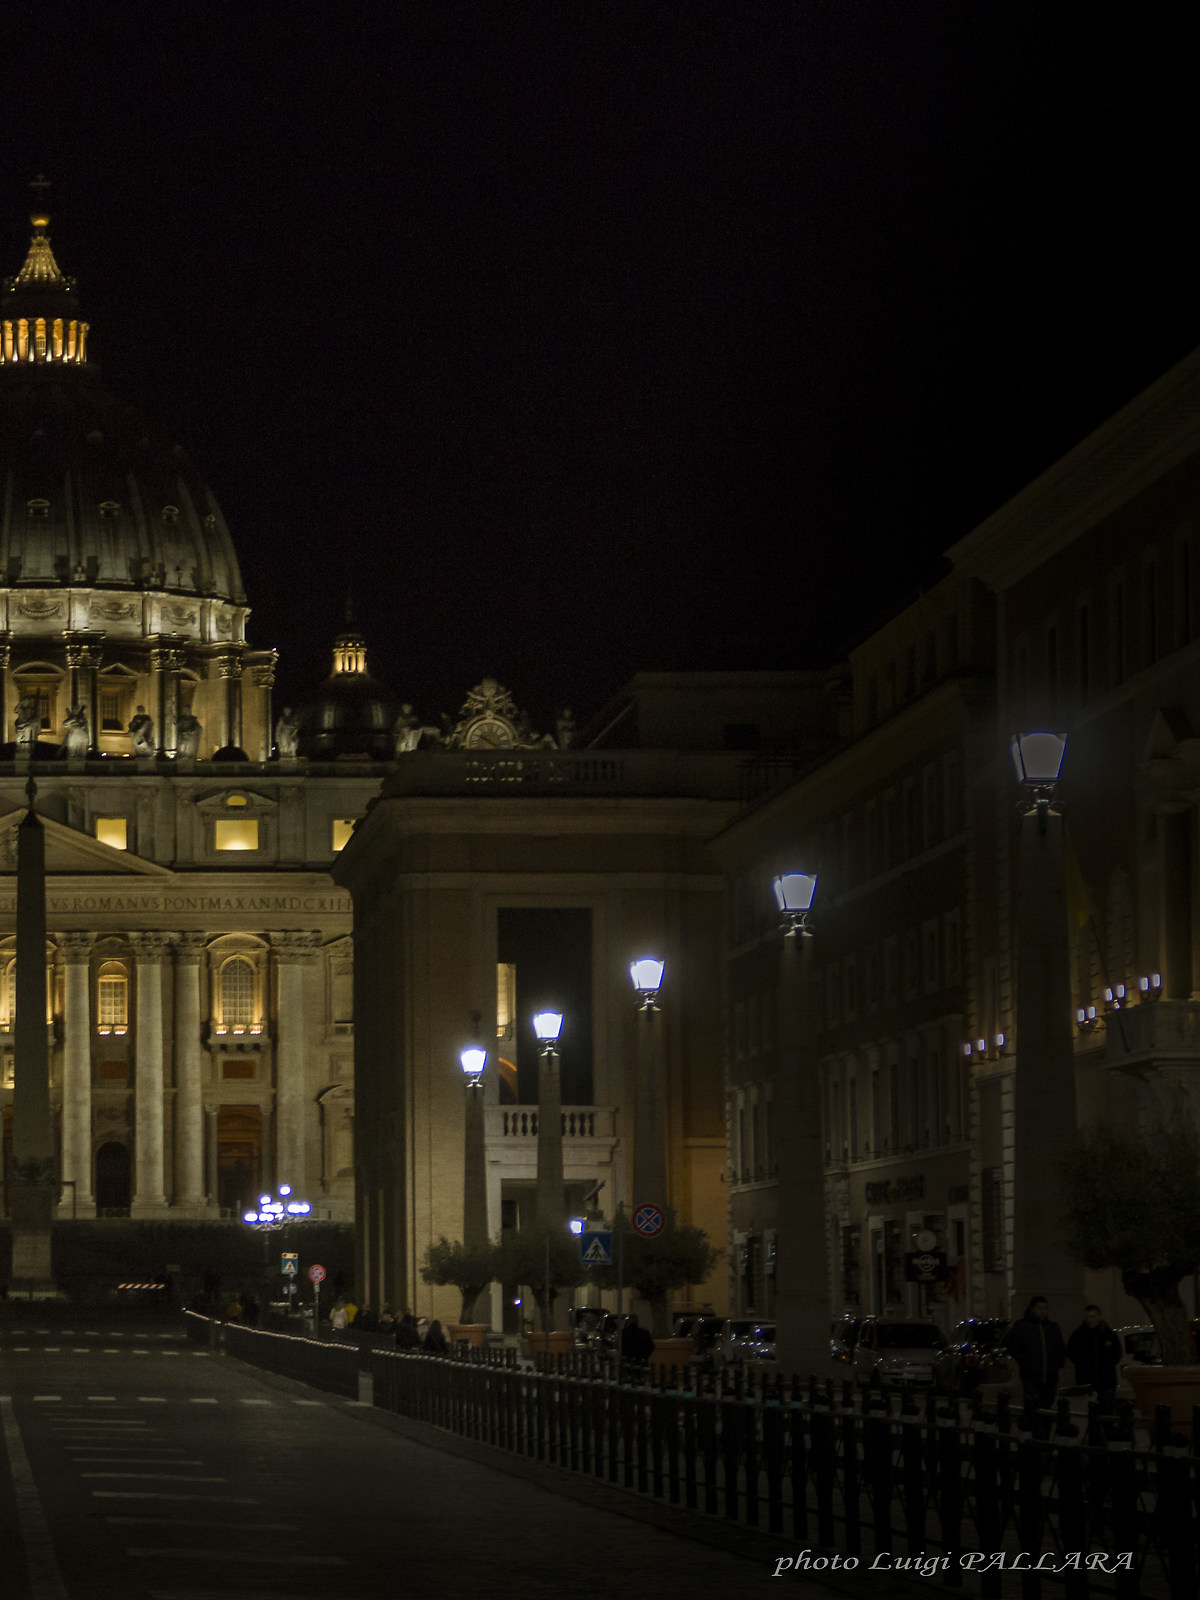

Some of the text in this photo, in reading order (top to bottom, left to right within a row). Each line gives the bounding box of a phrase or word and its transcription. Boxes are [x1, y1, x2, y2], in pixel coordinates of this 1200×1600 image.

[73, 897, 159, 910] ROMANVS
[163, 897, 207, 910] PONT
[208, 897, 246, 910] MAX
